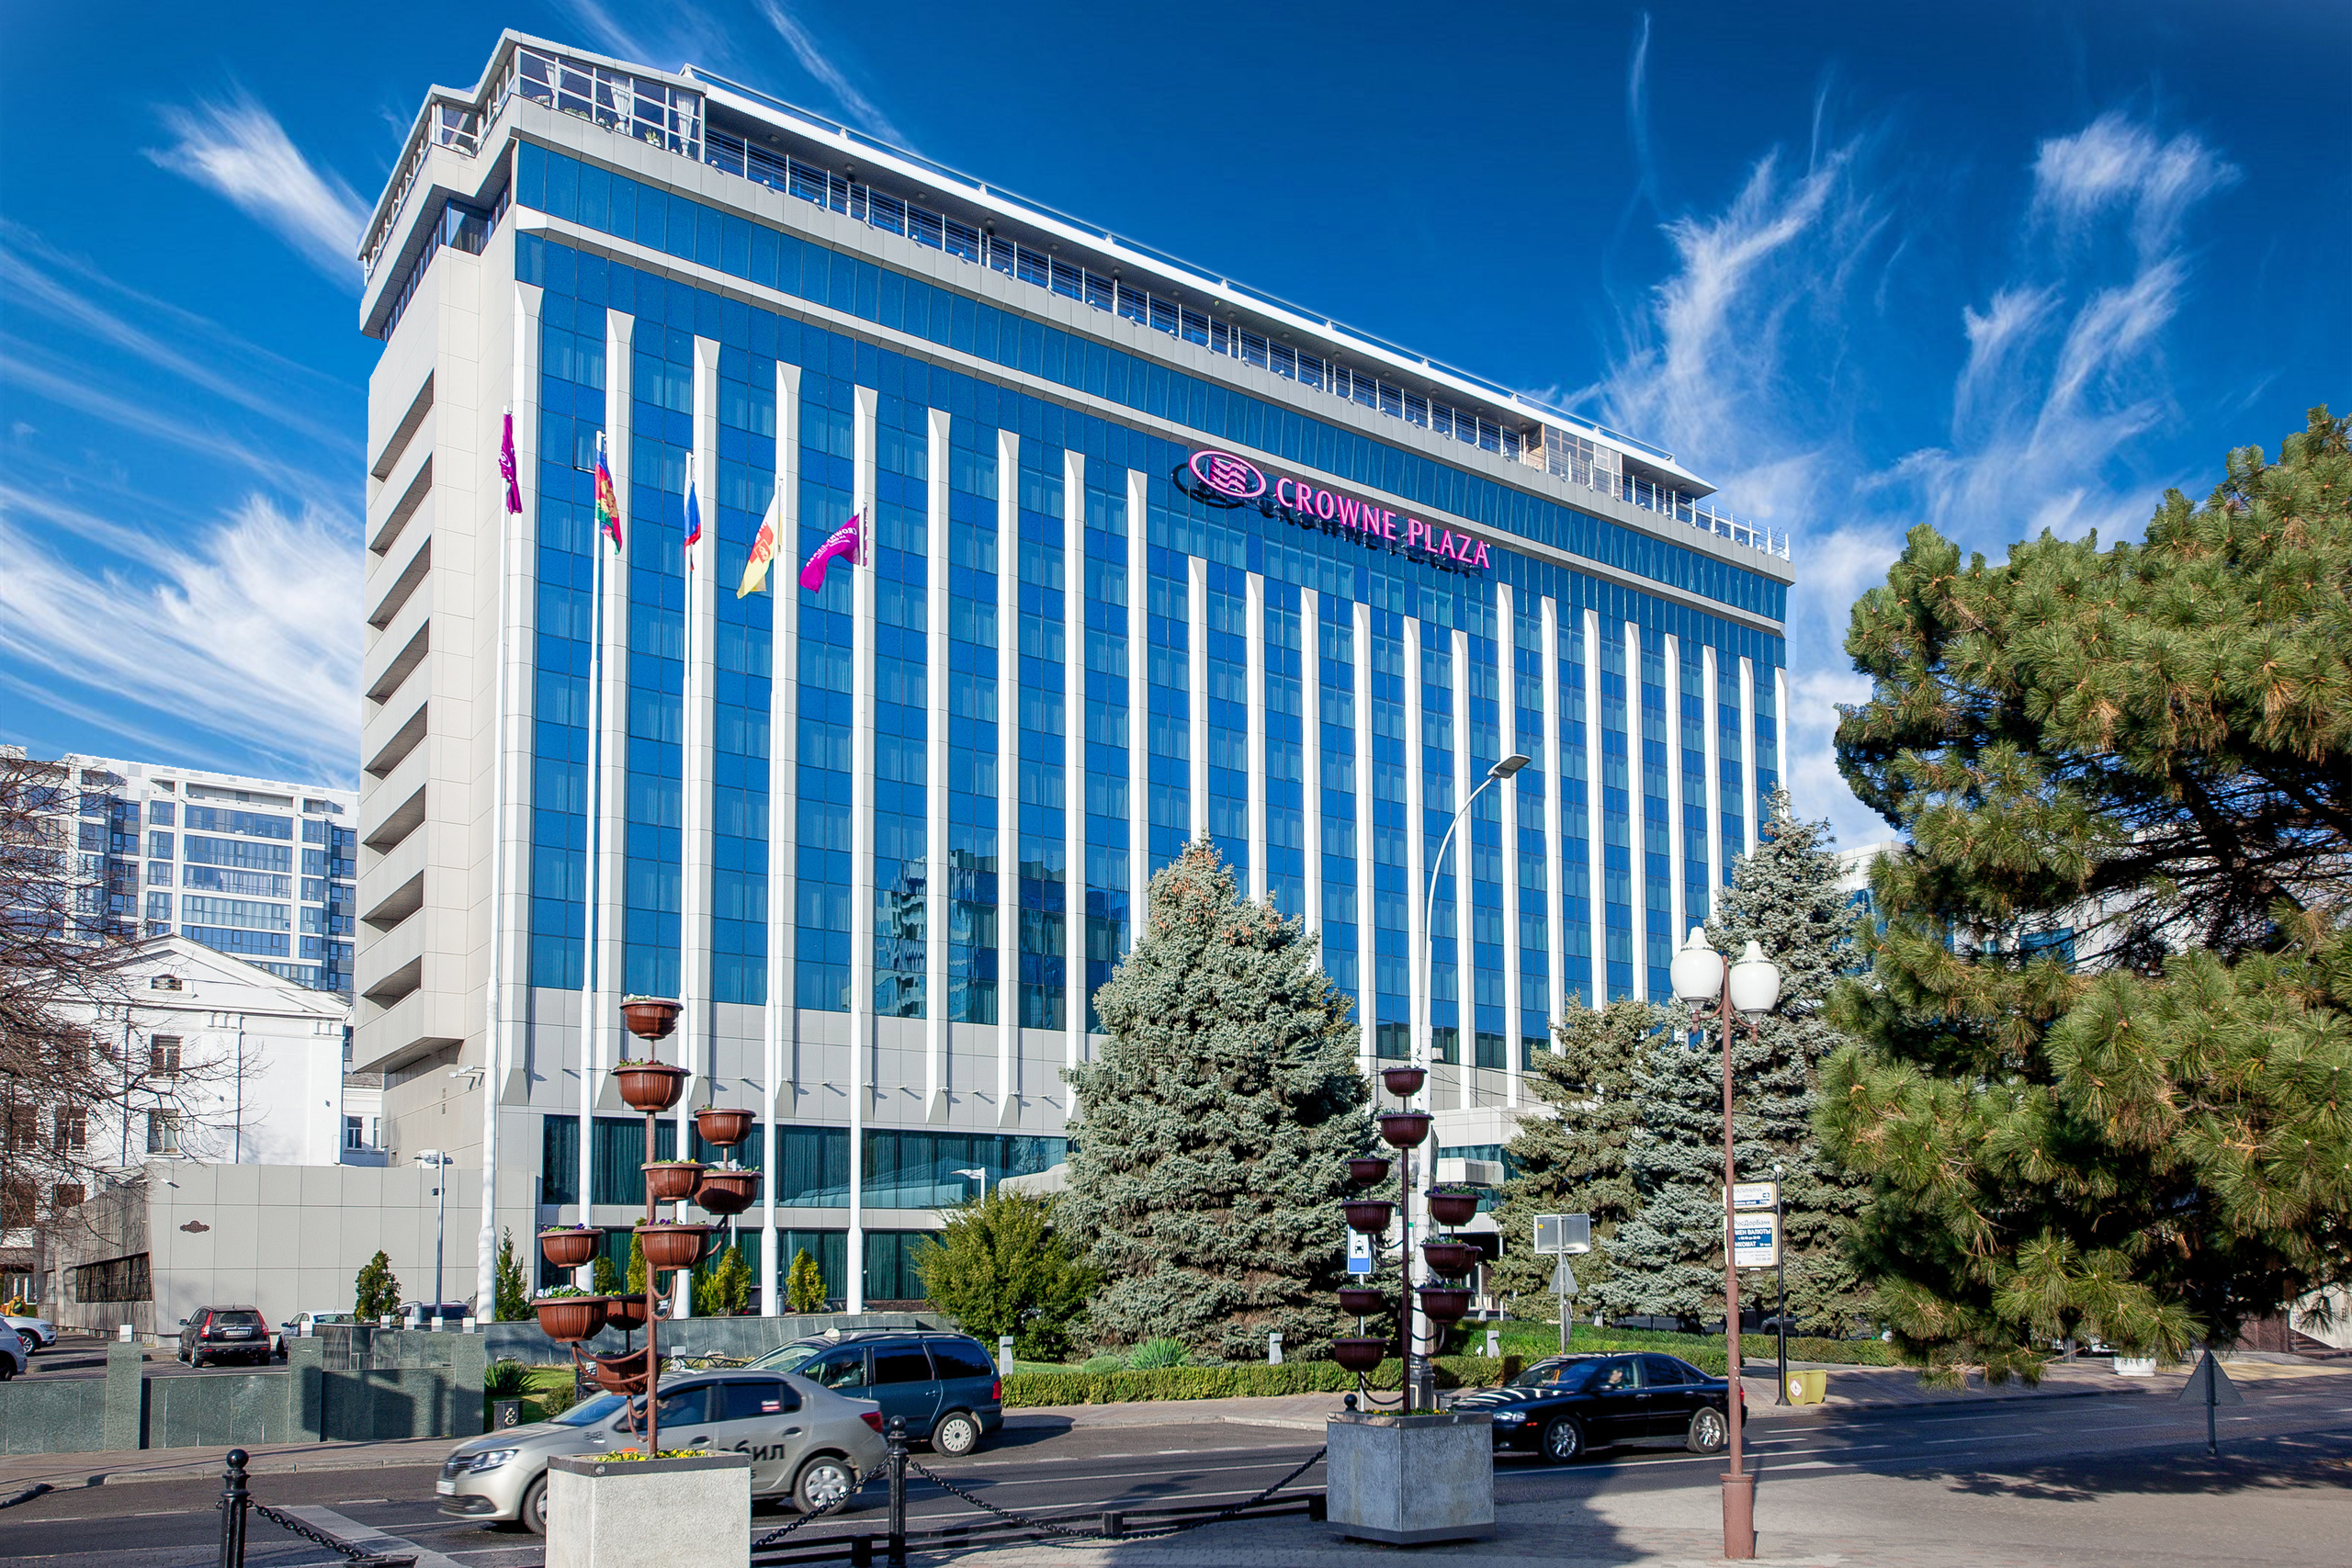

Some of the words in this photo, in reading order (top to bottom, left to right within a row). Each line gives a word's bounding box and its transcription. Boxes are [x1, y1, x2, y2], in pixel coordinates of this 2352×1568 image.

[1275, 477, 1397, 541] CROWNE
[1408, 517, 1490, 570] PLAZA
[718, 1438, 786, 1461] бил
